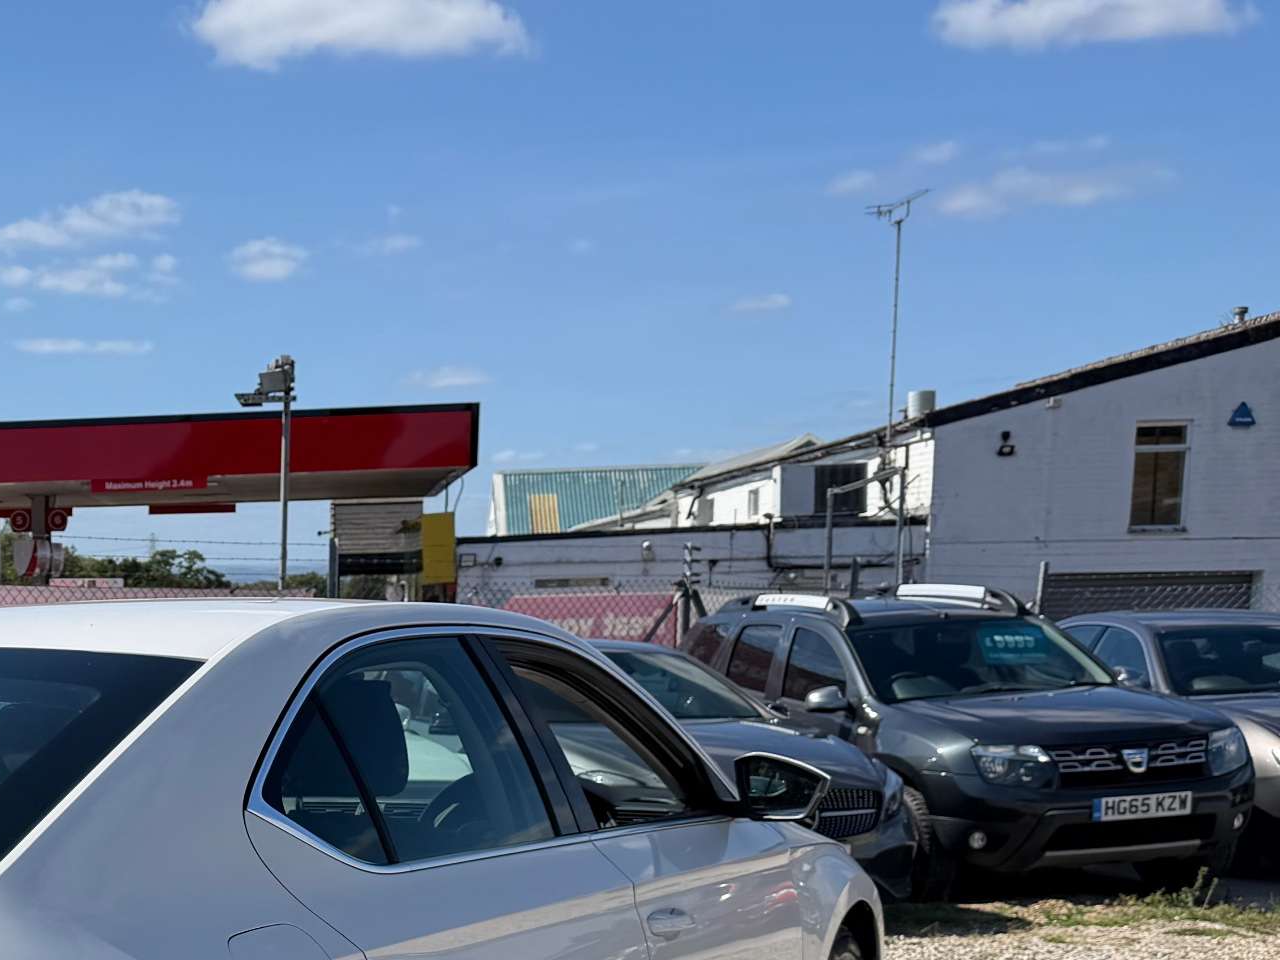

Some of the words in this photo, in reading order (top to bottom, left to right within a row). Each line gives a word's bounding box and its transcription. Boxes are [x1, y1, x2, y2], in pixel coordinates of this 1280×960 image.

[105, 481, 143, 490] Maximum
[144, 480, 170, 490] Height
[1104, 797, 1150, 816] HG65
[1154, 793, 1188, 812] KZW
